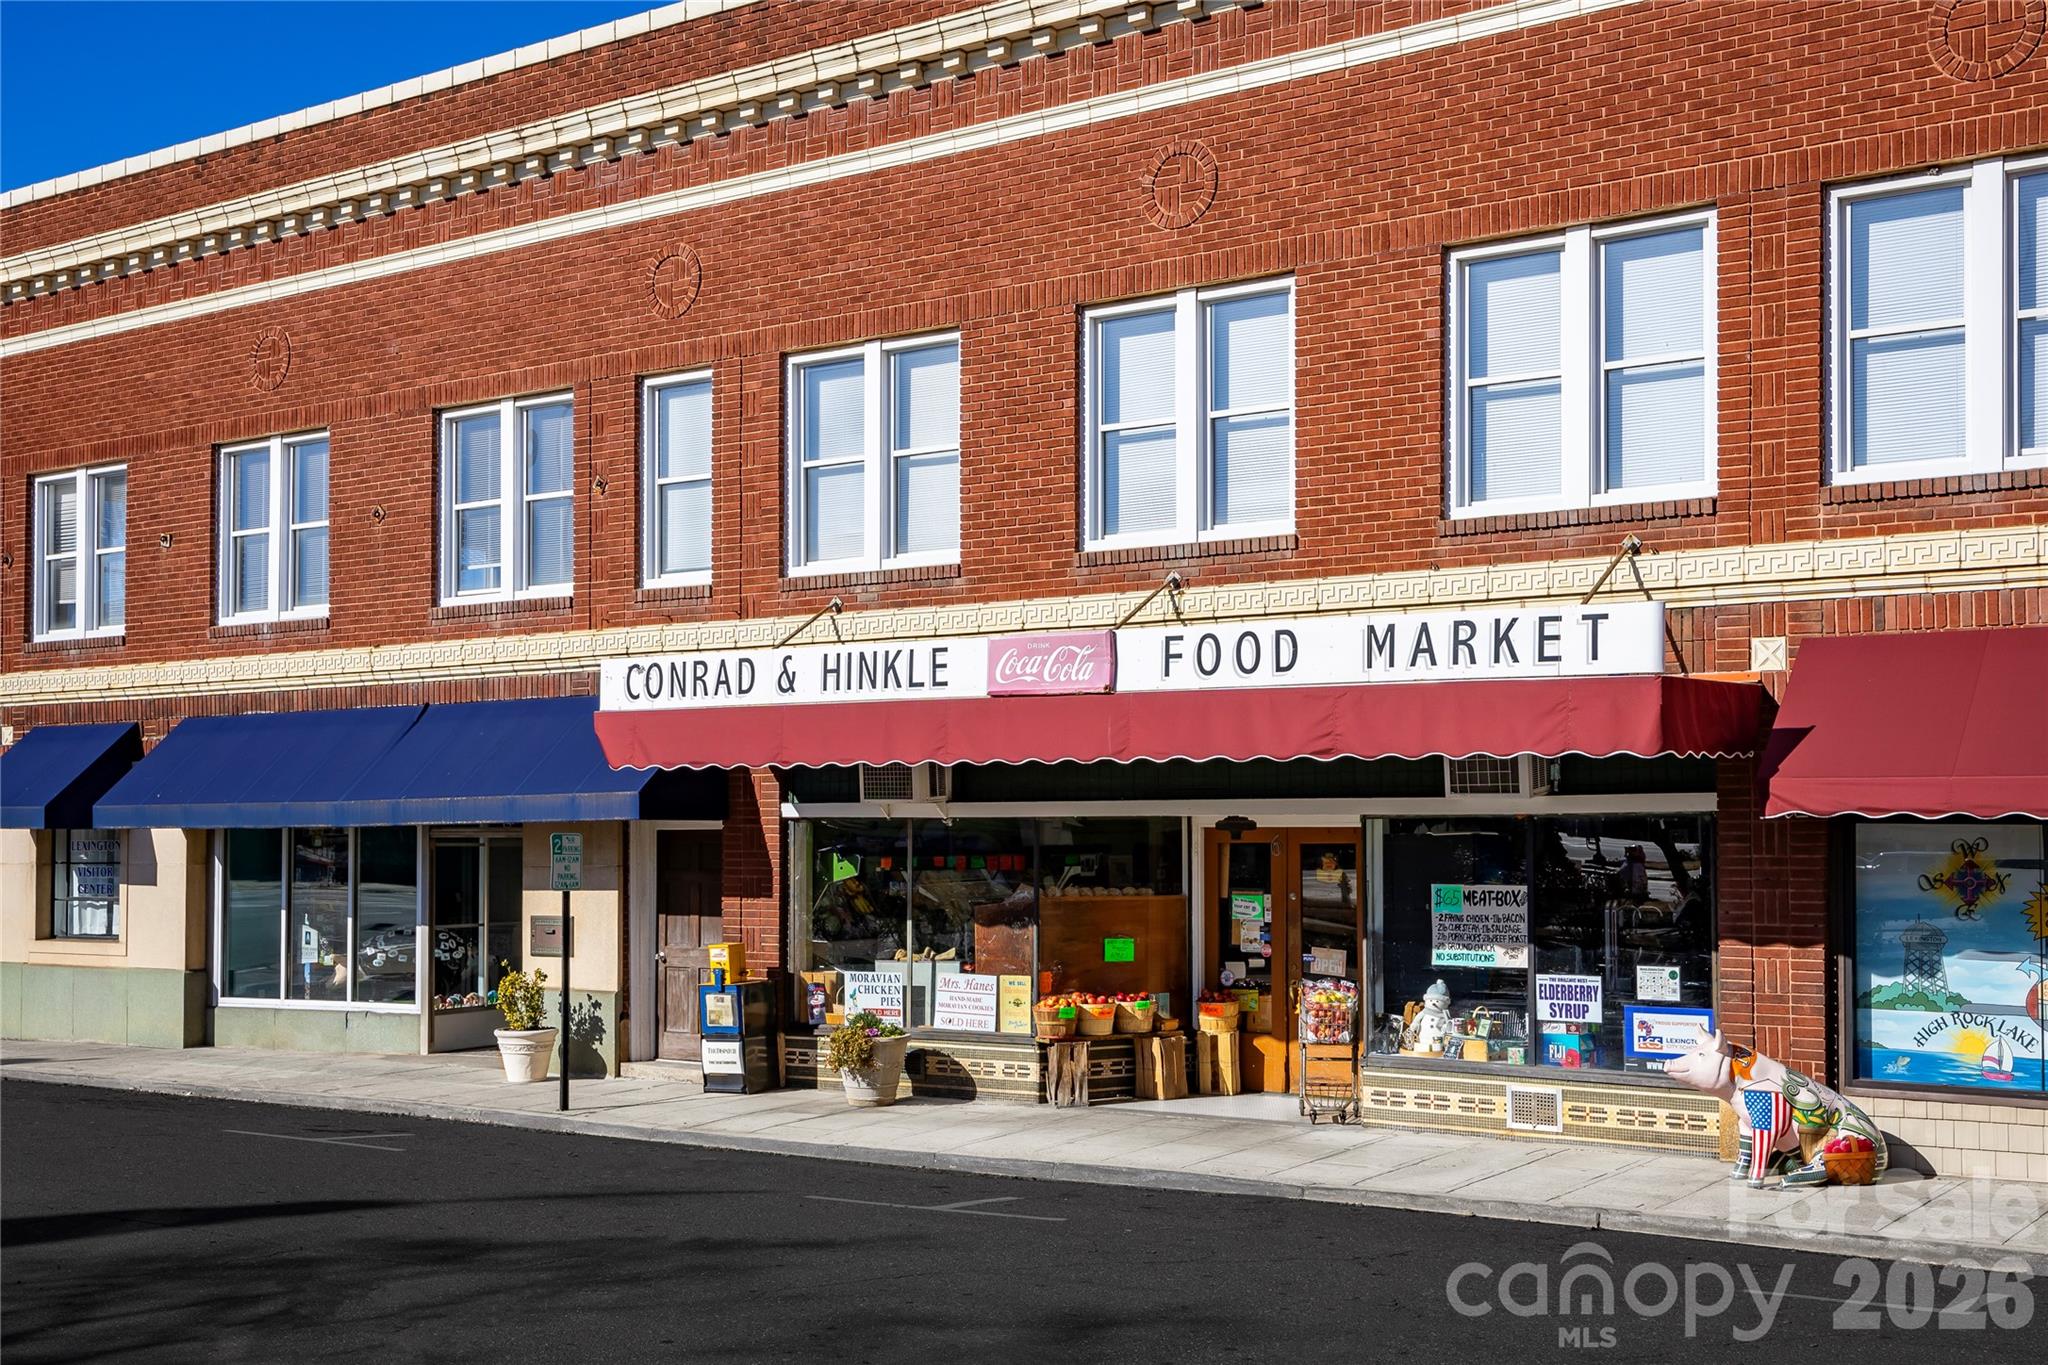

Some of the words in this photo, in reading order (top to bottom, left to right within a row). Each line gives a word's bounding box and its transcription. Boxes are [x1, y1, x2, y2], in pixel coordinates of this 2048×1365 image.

[1163, 629, 1298, 678] FOOD
[1366, 613, 1609, 669] MARKET
[626, 658, 756, 701] CONRAD
[777, 655, 797, 693] &
[822, 647, 949, 692] HINKLE
[72, 841, 120, 851] LEXINGTON
[554, 838, 561, 853] 2
[1951, 836, 1989, 859] W
[78, 866, 113, 877] VISITOR
[564, 864, 571, 872] NO
[1918, 872, 1944, 892] S
[1984, 872, 2012, 895] N
[78, 883, 113, 895] CENTER
[1435, 888, 1460, 908] $65
[1463, 889, 1521, 908] MEAT-BOX
[1466, 914, 1489, 923] CHICKEN
[1502, 913, 1526, 923] BACON
[1491, 924, 1522, 934] SAUSAGE
[1493, 935, 1507, 943] BEEF
[1508, 935, 1527, 944] ROAST
[1448, 943, 1473, 951] GROUND
[1435, 952, 1445, 961] NO
[1446, 952, 1495, 963] SUBSTITUTIONS
[1314, 957, 1343, 973] OPEN
[849, 973, 901, 984] MORAVIAN
[940, 977, 961, 989] Mrs.
[963, 977, 995, 992] Hanes
[857, 984, 901, 995] CHICKEN
[1539, 983, 1599, 1002] ELDERBERRY
[880, 997, 902, 1007] PIES
[938, 1001, 968, 1010] MORAVIAN
[969, 1003, 994, 1012] COOKIES
[1549, 1002, 1589, 1019] SYRUP
[940, 1016, 964, 1027] SOLD
[965, 1018, 990, 1029] HERE
[1913, 1017, 1949, 1048] HIGH
[1950, 1011, 1999, 1038] ROCK
[1997, 1019, 2040, 1054] LAKE
[1638, 1036, 1663, 1049] LCS
[1549, 1044, 1566, 1060] FIJI
